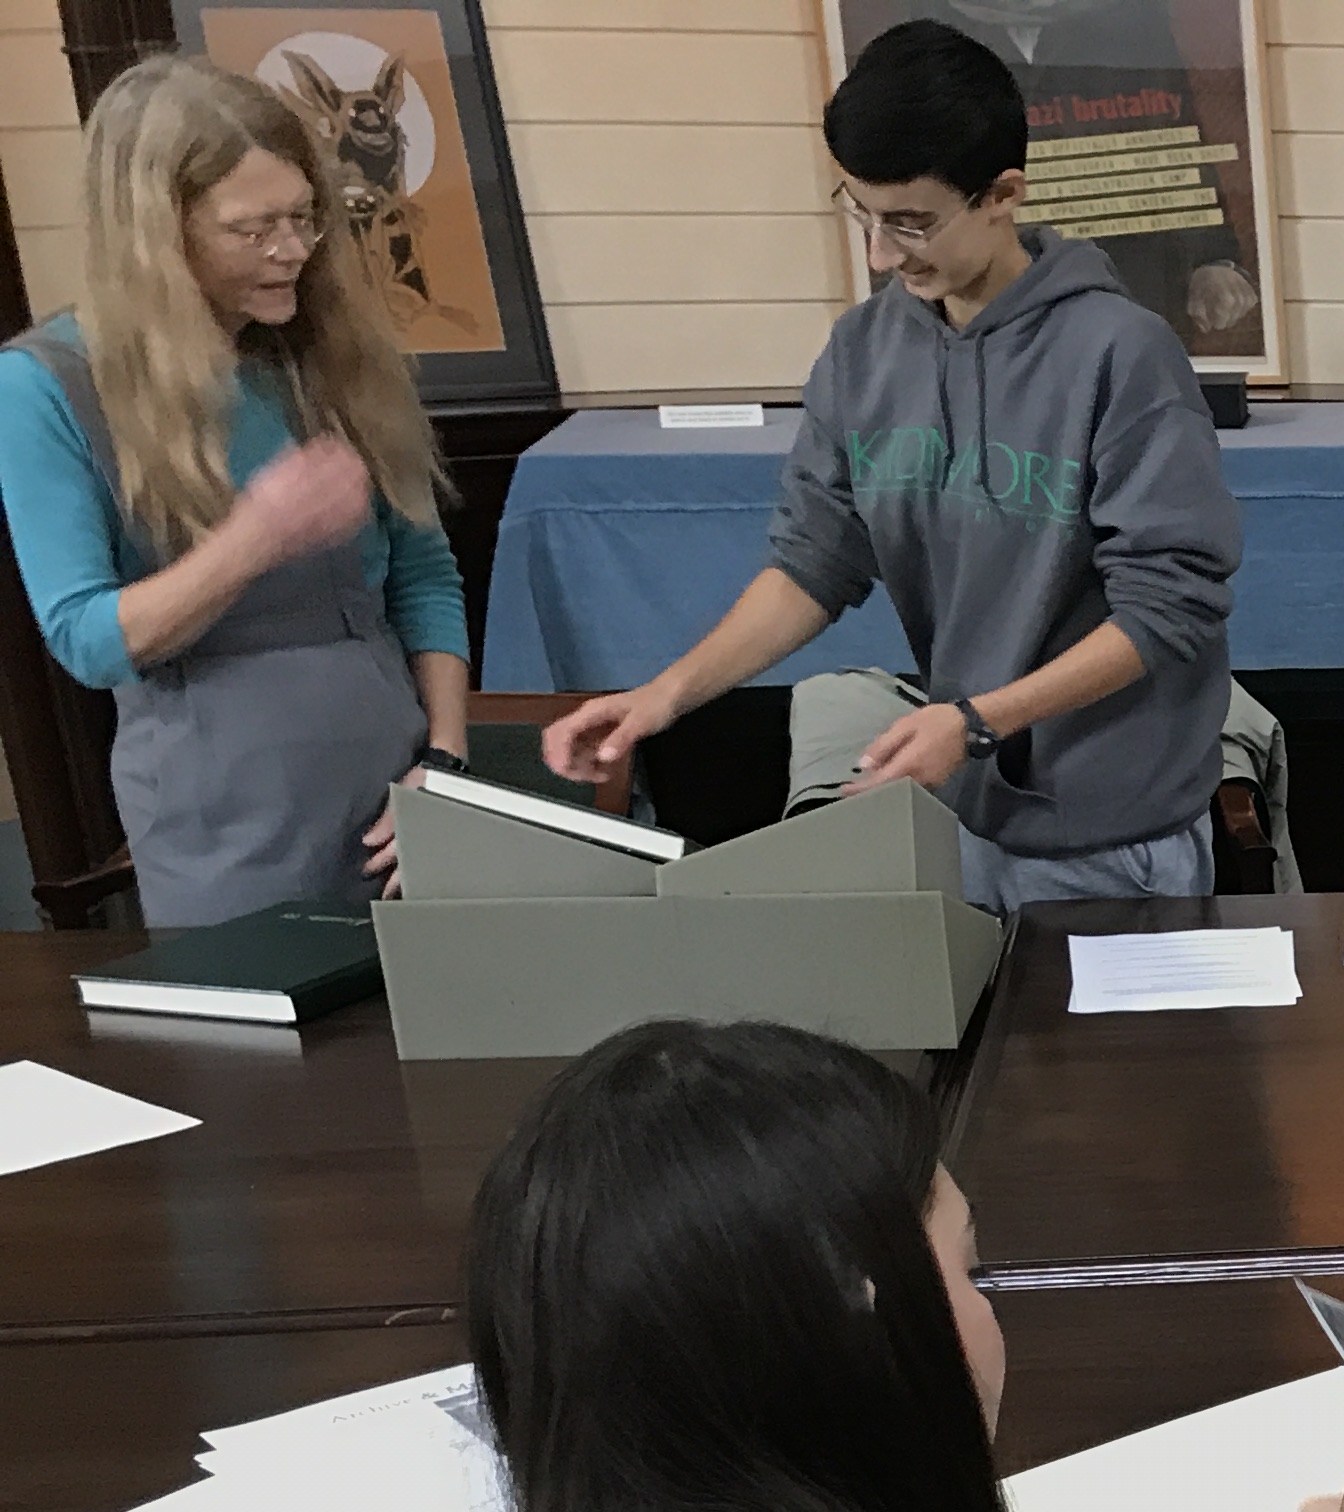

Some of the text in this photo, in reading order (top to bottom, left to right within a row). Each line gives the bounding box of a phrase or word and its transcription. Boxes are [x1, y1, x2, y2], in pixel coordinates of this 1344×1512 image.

[1027, 88, 1182, 127] azi brutality
[850, 426, 1081, 514] KIDMORE
